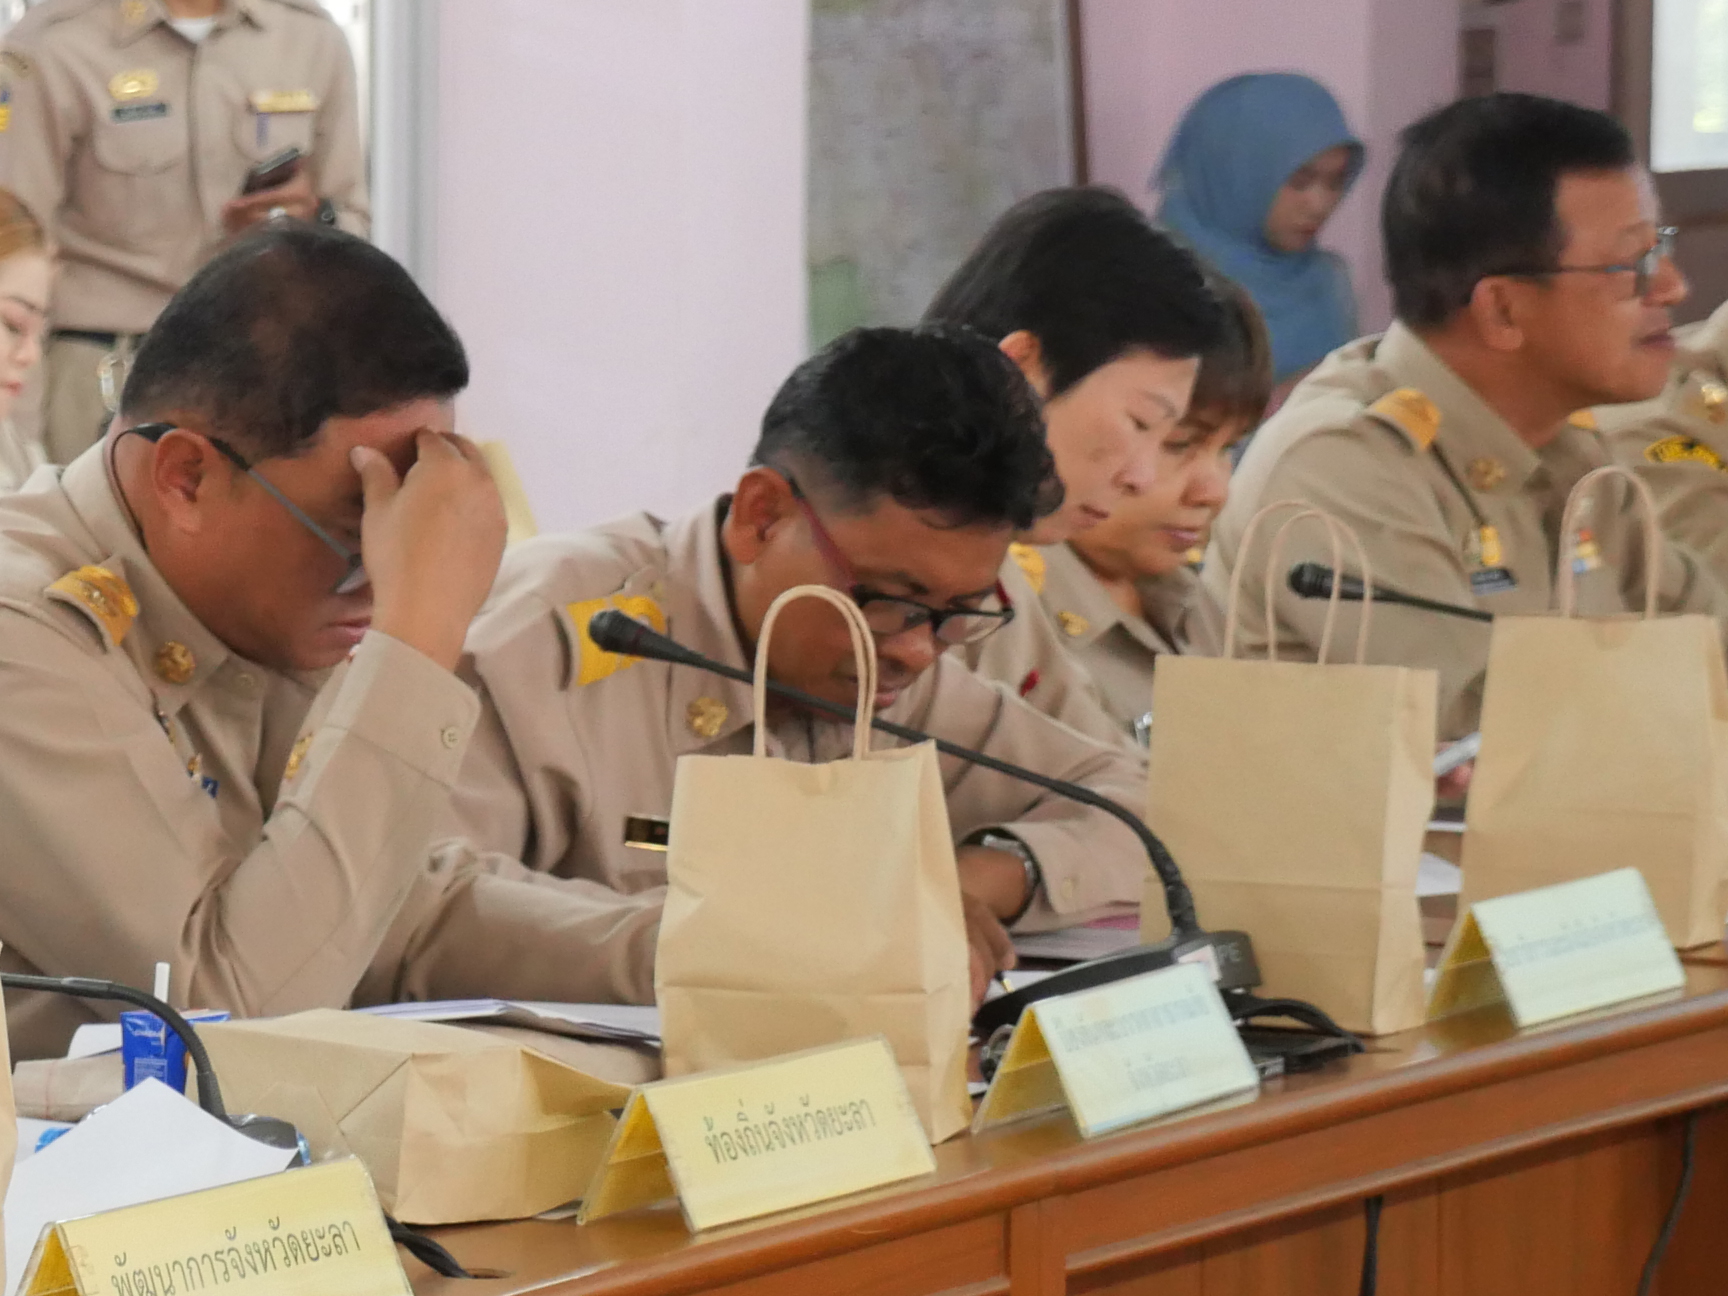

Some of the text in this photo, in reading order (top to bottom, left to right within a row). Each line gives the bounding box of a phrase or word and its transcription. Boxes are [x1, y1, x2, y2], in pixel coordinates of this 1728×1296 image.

[703, 1093, 878, 1165] ท้องถิ่นจังหวัดยะลา
